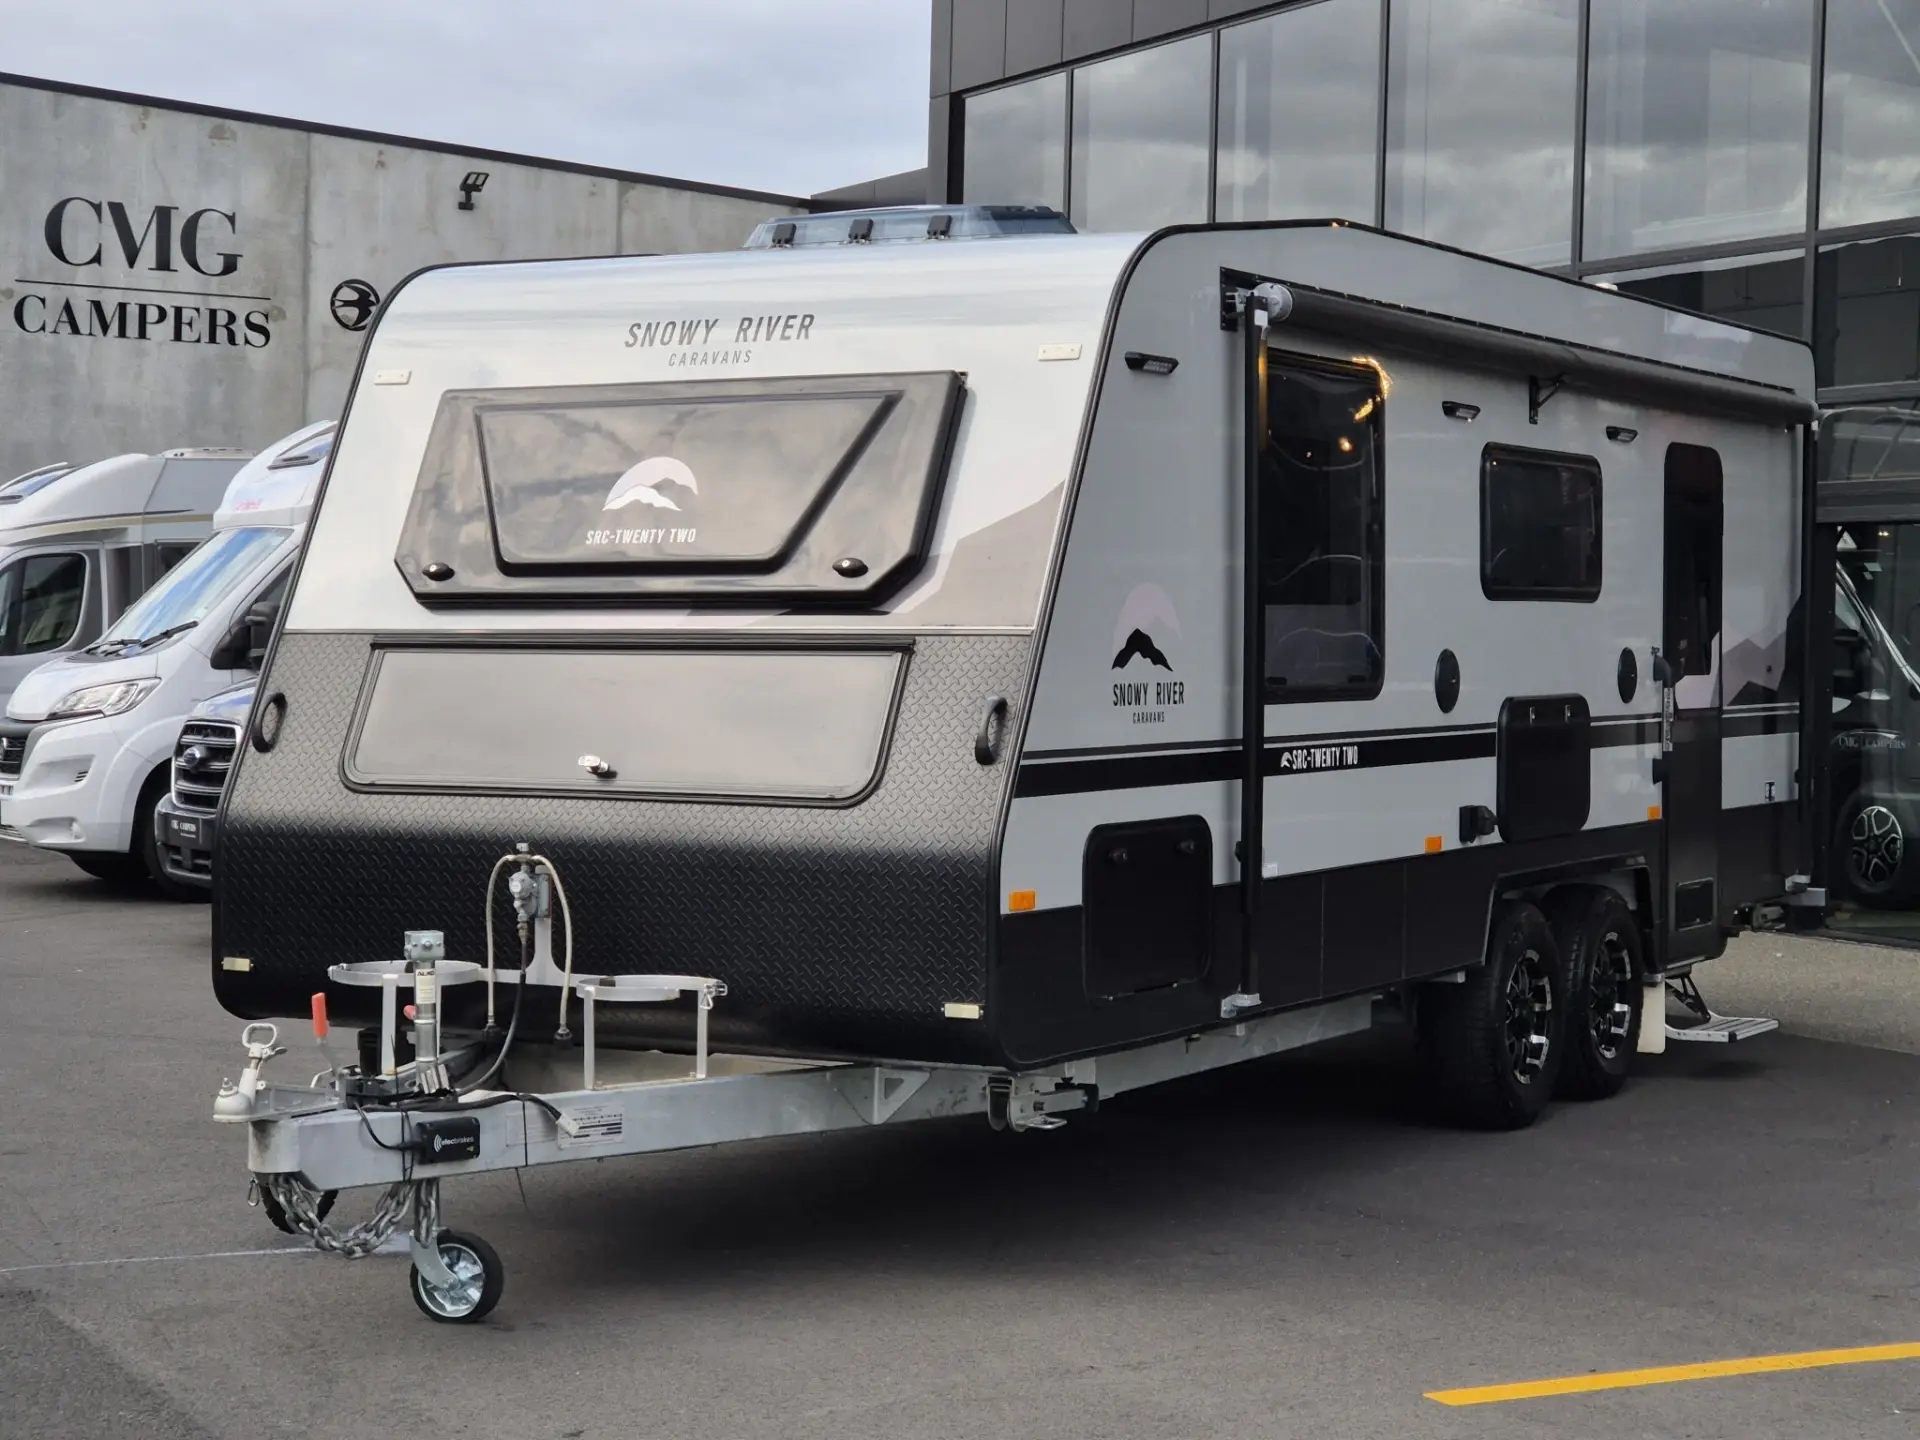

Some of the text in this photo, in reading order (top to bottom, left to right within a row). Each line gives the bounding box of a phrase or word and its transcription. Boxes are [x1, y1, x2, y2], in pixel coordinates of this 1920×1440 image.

[44, 196, 243, 277] CMG
[13, 294, 272, 348] CAMPERS
[624, 313, 815, 348] SNOWY RIVER
[668, 349, 752, 367] CARAVANS
[585, 528, 697, 545] SRC-TWENTY TWO
[1112, 681, 1185, 707] SNOWY RIVER
[1132, 711, 1165, 724] CARAVANS
[1292, 745, 1359, 770] SRC-TWENTY TWO
[441, 1136, 475, 1146] elecbrakes
